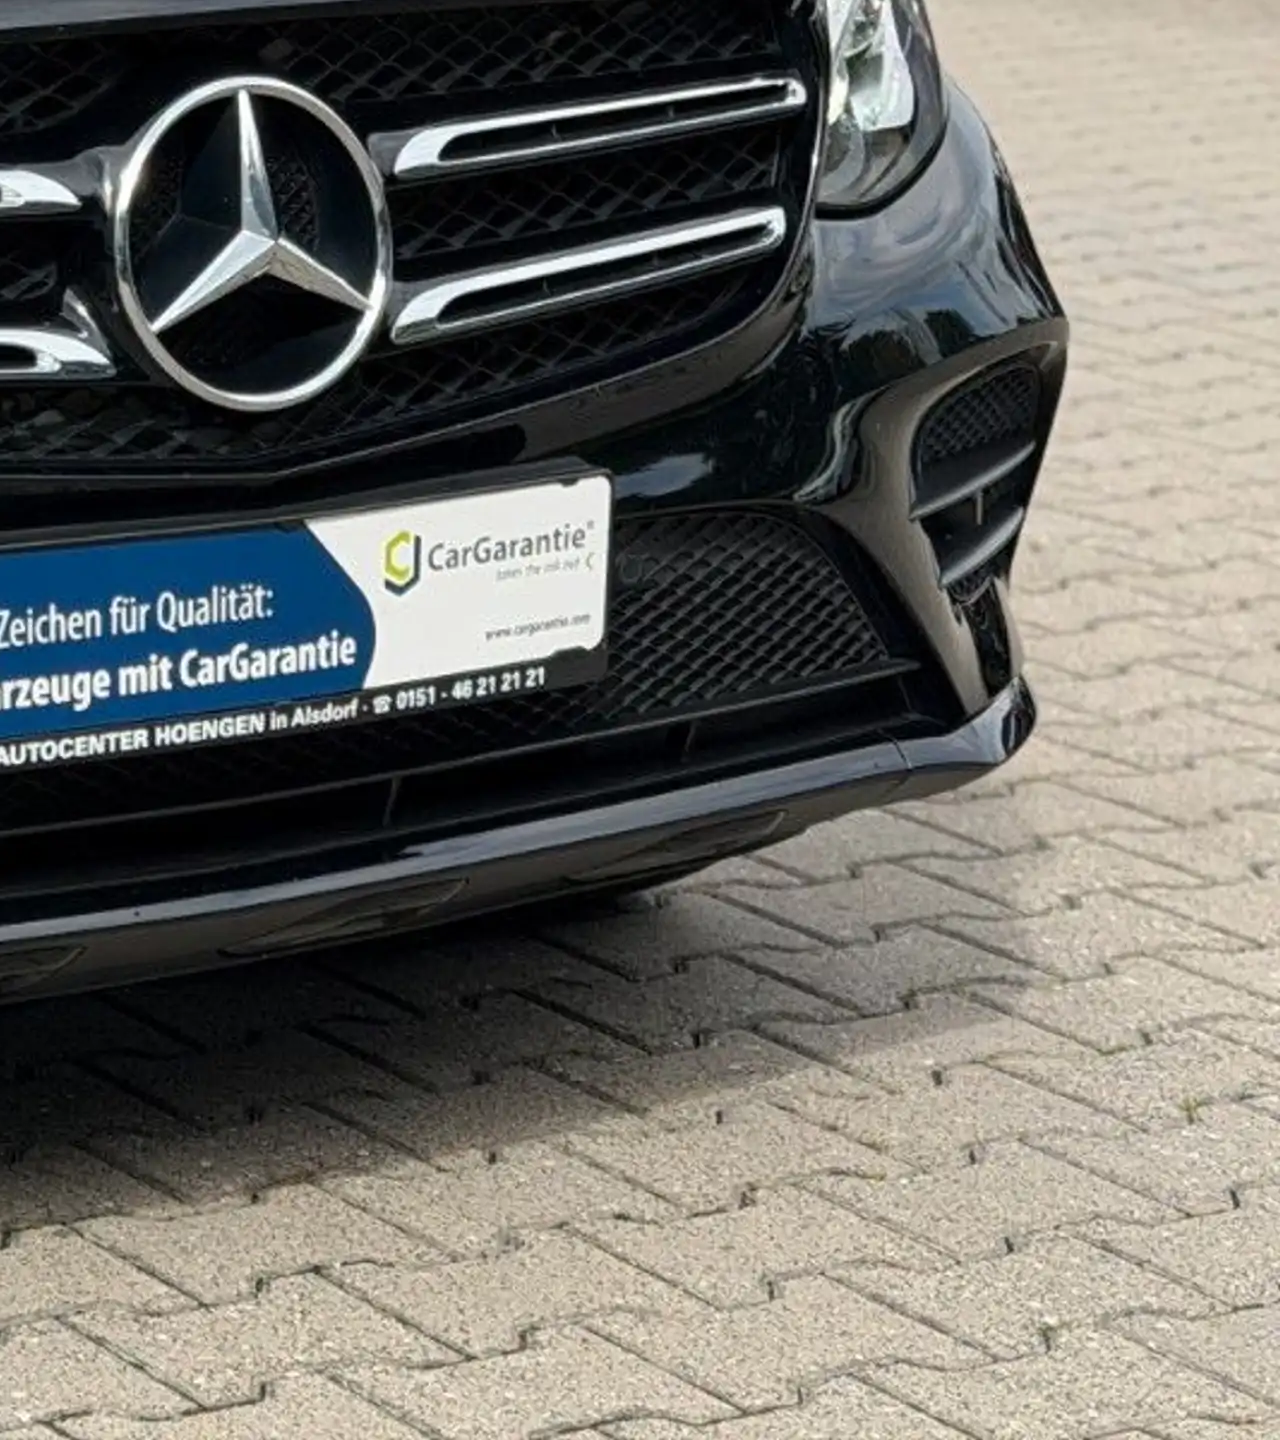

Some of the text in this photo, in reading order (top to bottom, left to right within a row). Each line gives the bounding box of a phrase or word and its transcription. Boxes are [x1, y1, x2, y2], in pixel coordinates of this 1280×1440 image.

[109, 595, 151, 636] für
[156, 583, 274, 633] Qualität:
[118, 653, 173, 696] mit
[179, 628, 357, 688] CarGarantie
[154, 712, 266, 747] HOENGEN
[269, 711, 288, 731] in
[291, 697, 359, 728] Alsdorf
[396, 686, 436, 711] 0151
[451, 678, 473, 700] 46
[476, 675, 496, 695] 21
[500, 671, 521, 692] 21
[525, 666, 545, 688] 21
